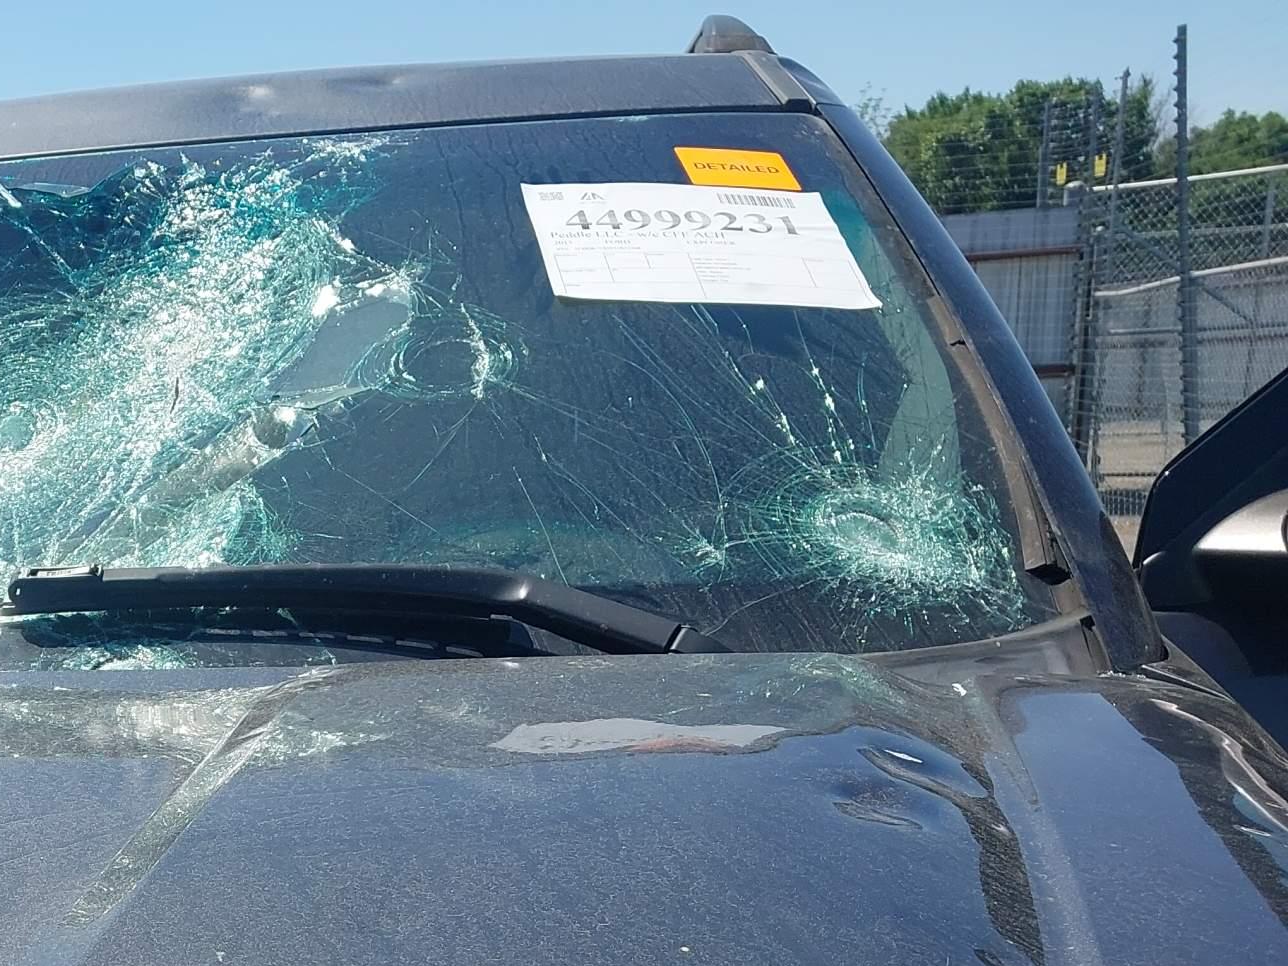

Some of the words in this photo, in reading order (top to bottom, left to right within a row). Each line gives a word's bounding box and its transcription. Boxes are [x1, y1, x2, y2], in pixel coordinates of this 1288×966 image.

[693, 162, 780, 174] DETAILED
[566, 209, 800, 236] 44999231
[549, 231, 591, 239] Peddle
